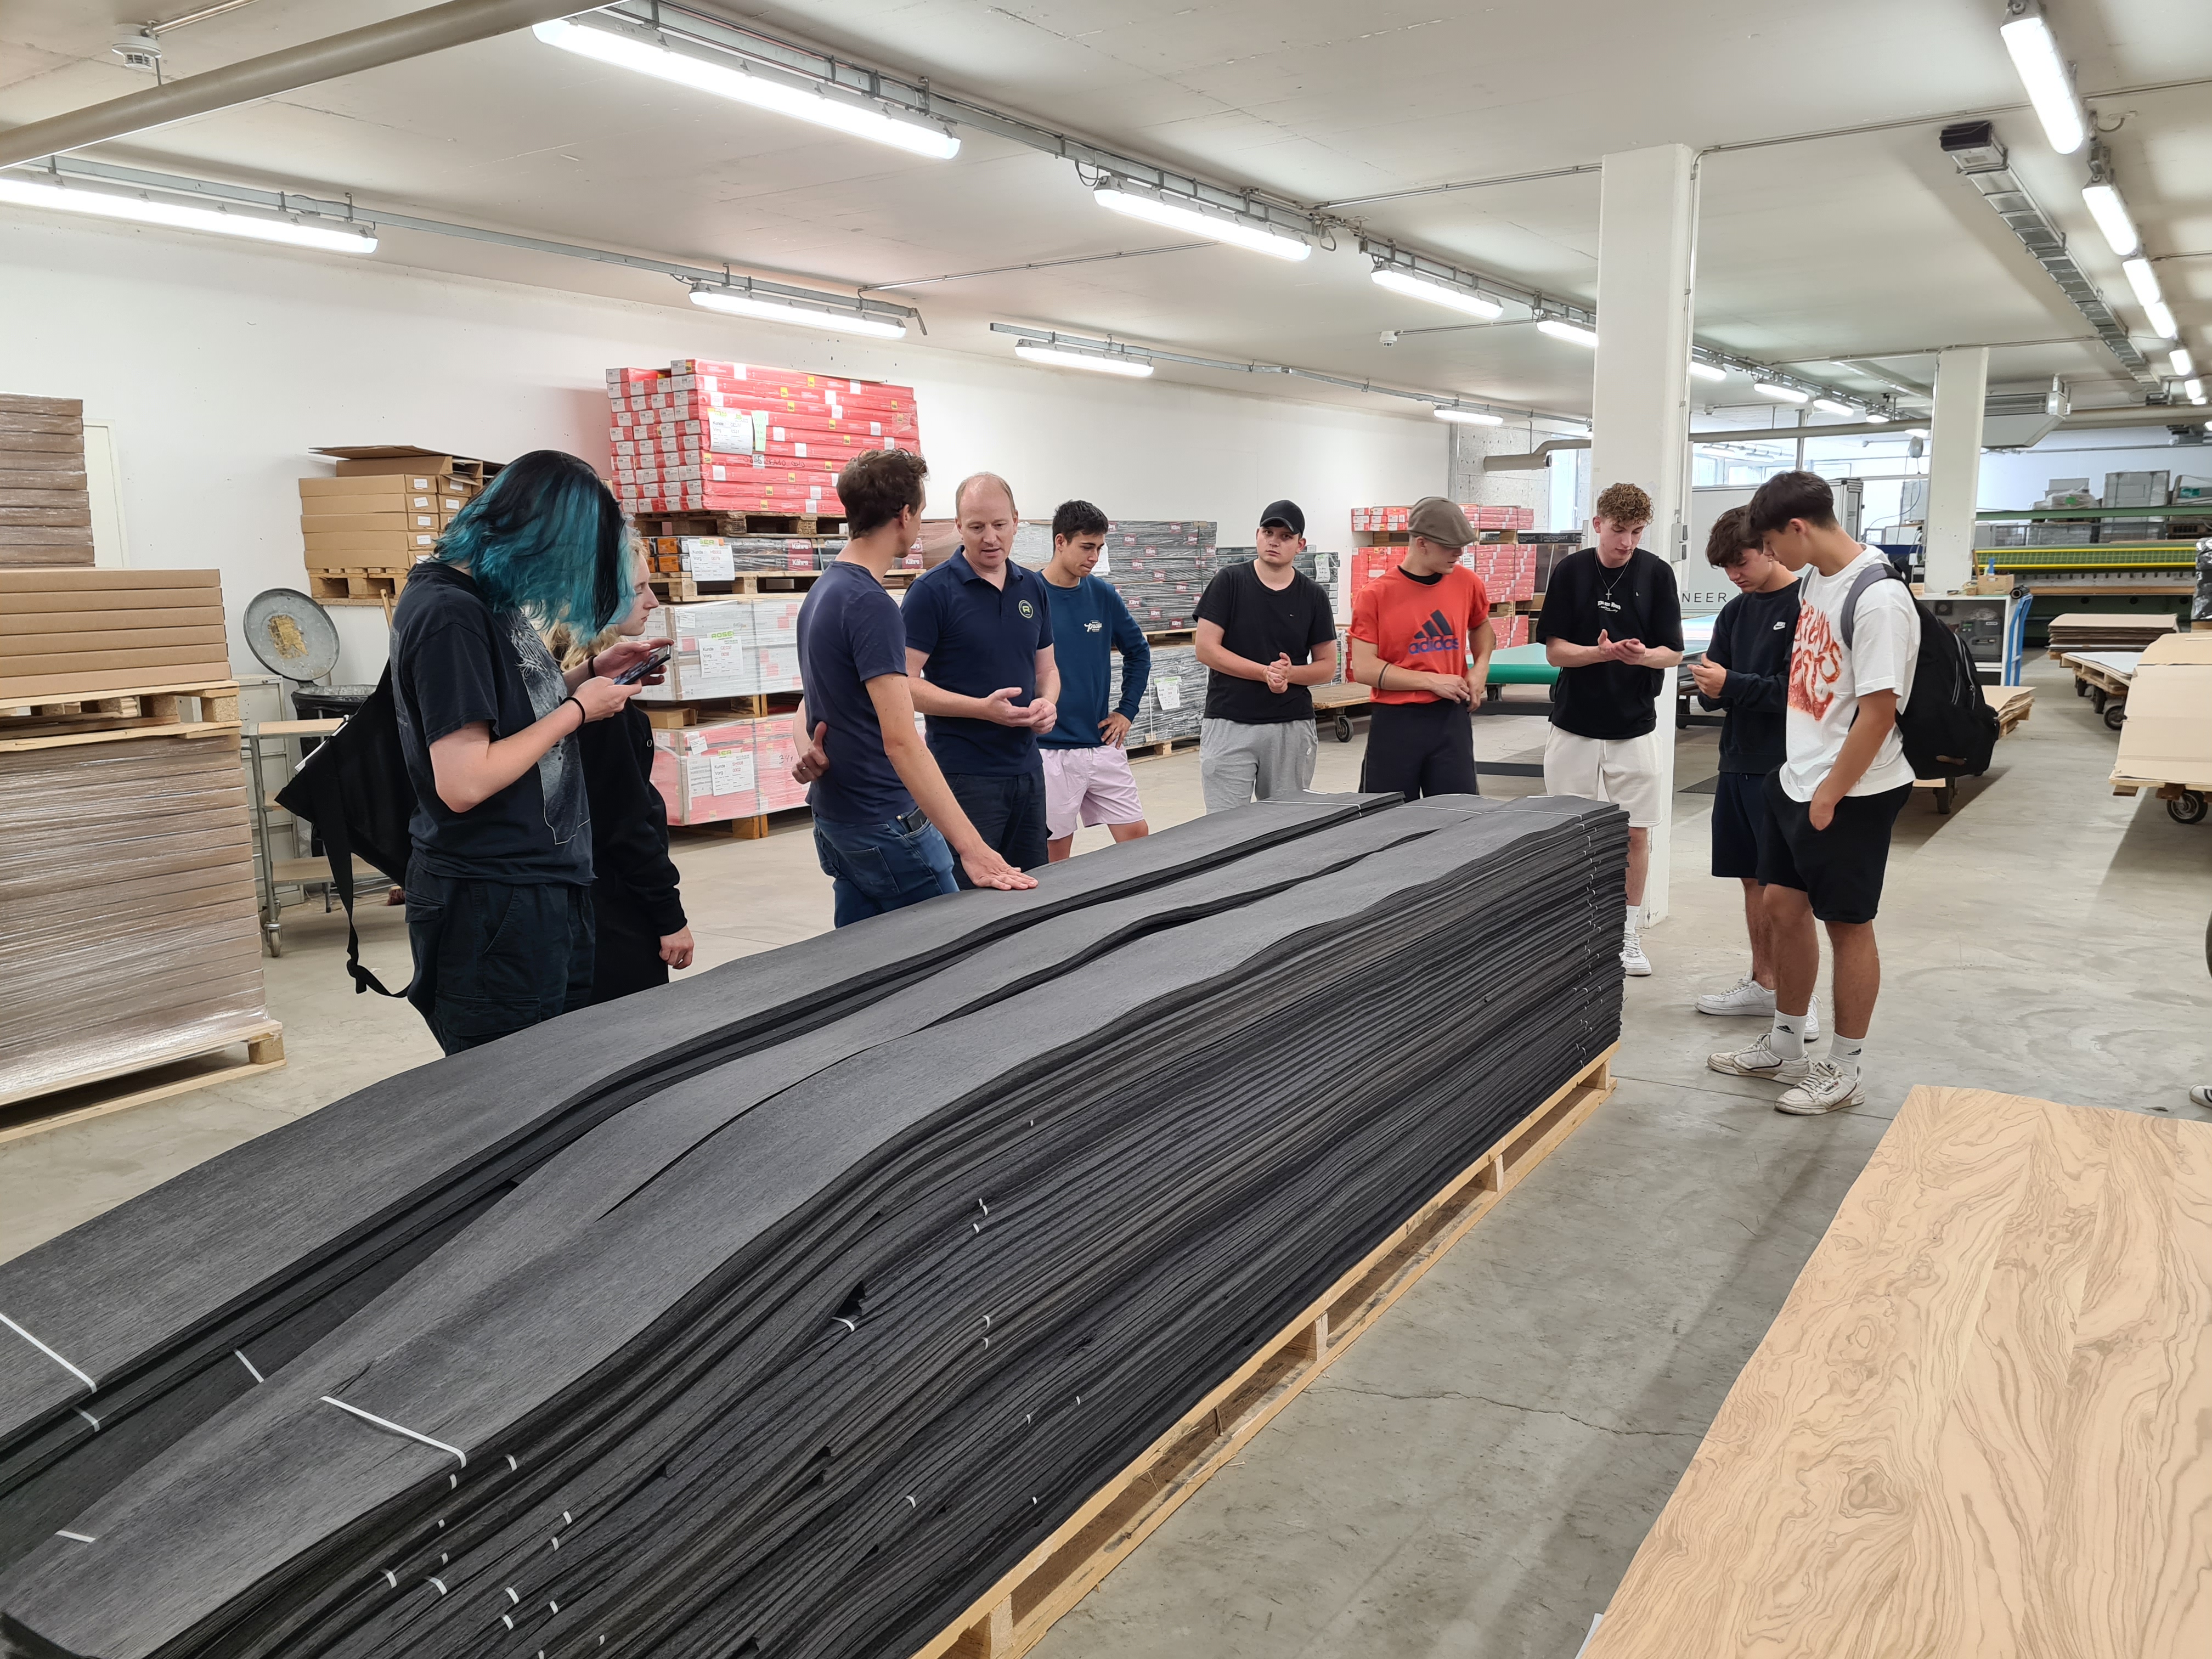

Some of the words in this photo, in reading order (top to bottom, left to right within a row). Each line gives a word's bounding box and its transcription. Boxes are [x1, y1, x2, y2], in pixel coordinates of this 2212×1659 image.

[792, 541, 809, 549] Kährs
[1681, 592, 1727, 602] NEER
[1408, 636, 1459, 654] adidas
